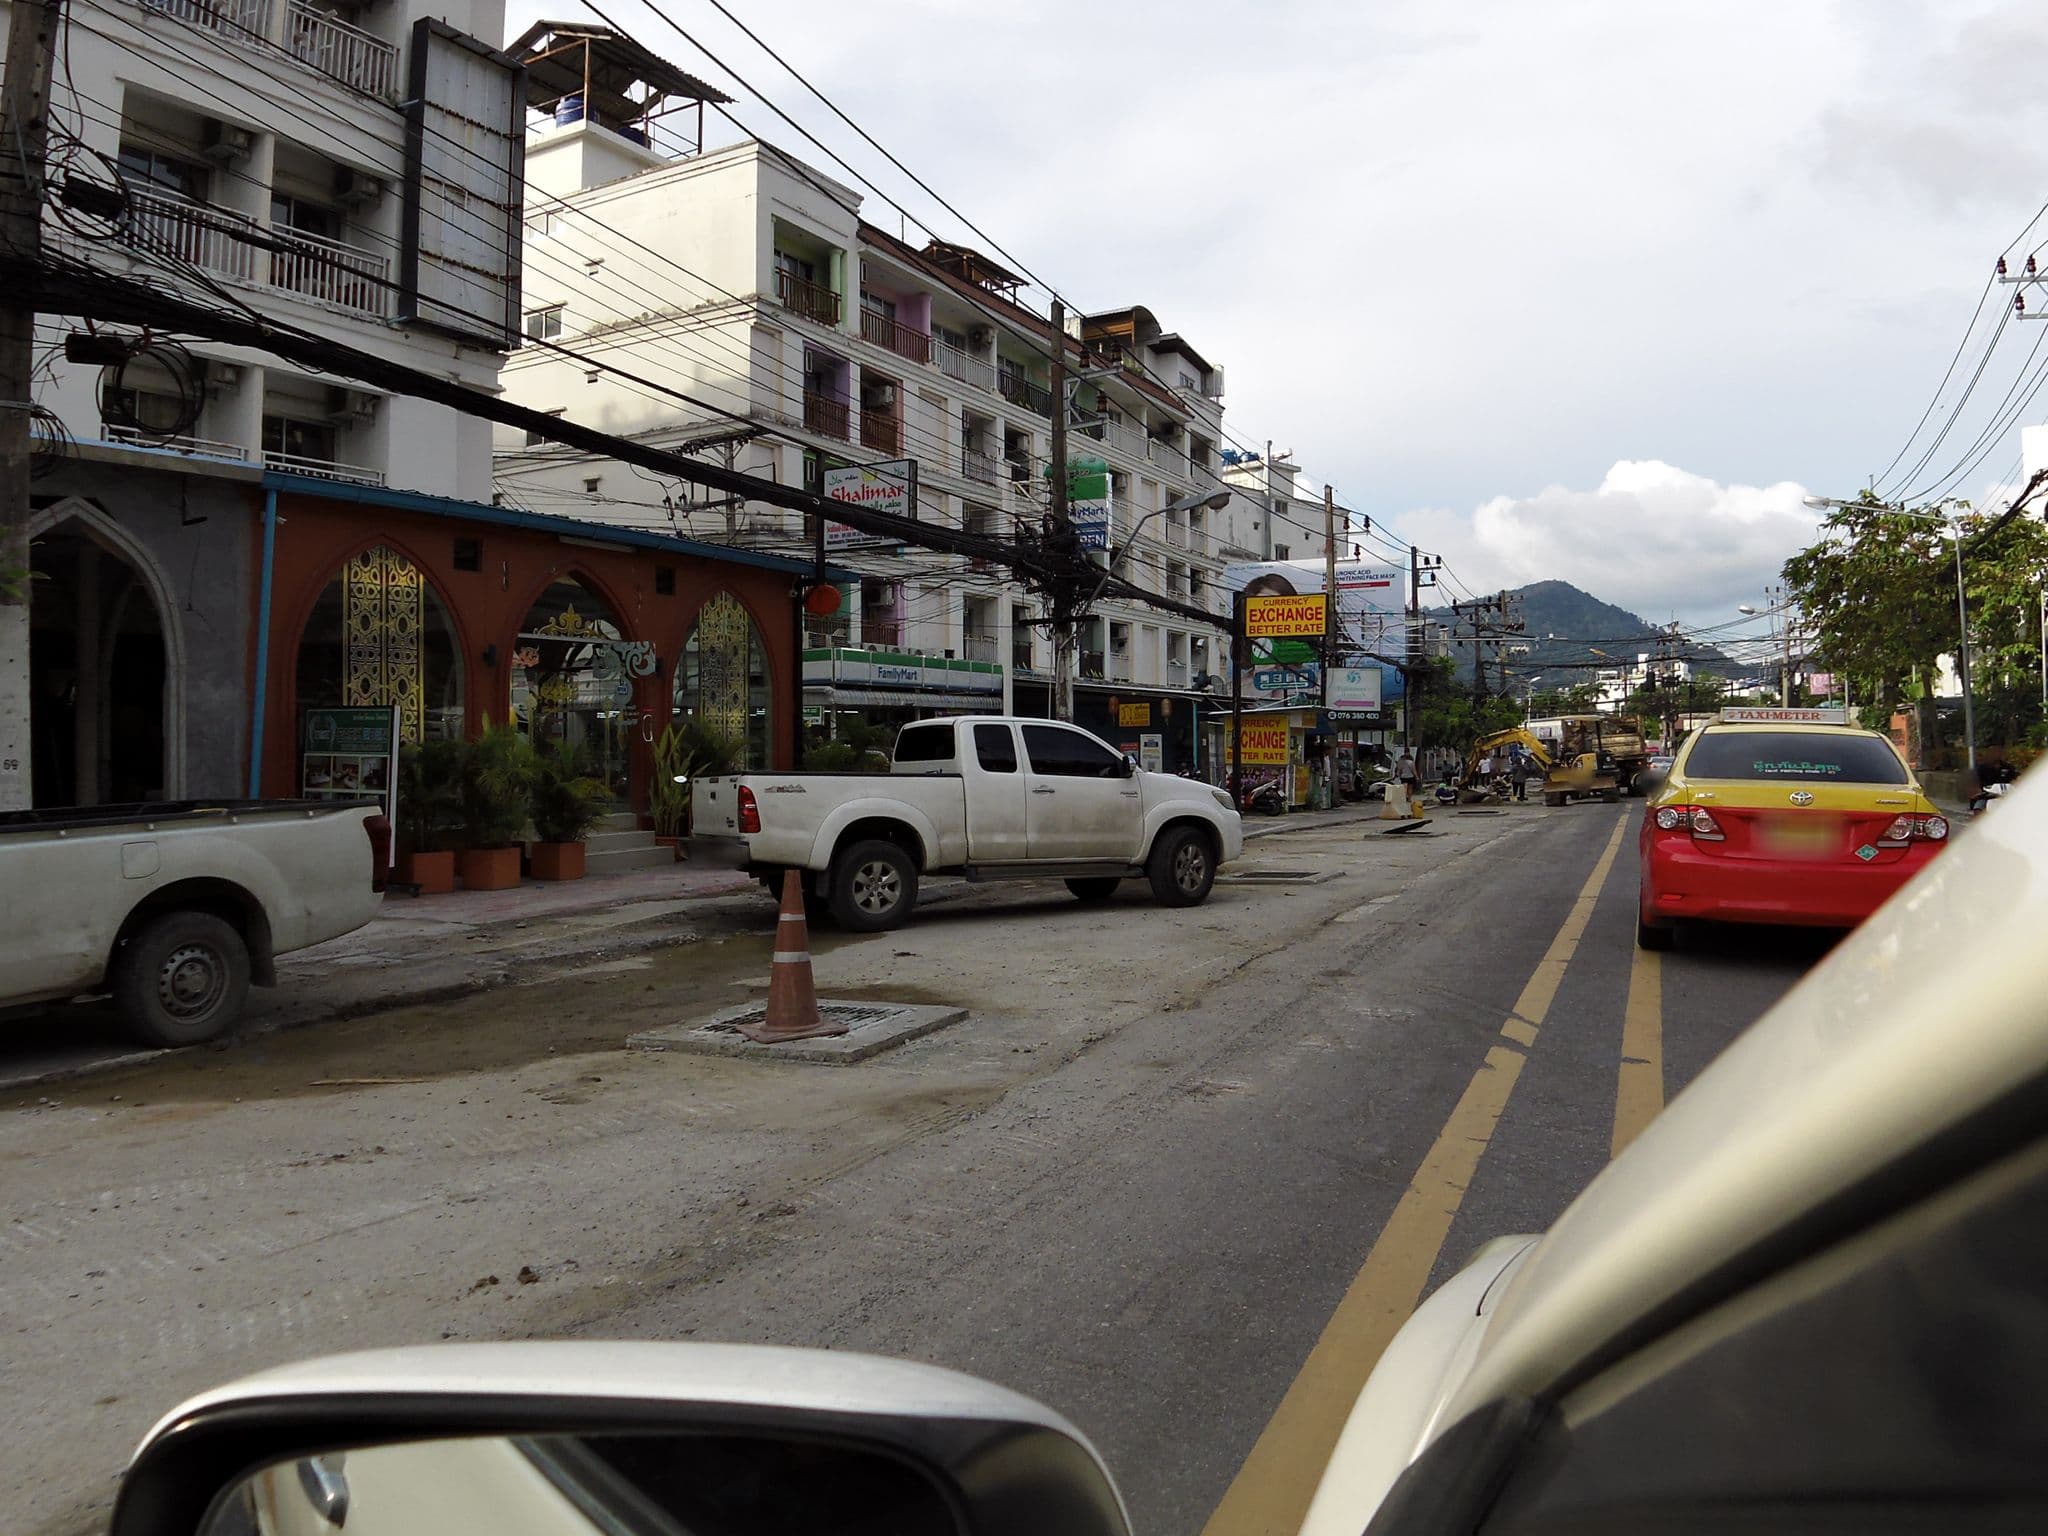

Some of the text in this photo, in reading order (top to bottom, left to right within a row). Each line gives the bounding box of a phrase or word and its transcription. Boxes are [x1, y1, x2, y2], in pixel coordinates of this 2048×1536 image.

[831, 484, 905, 502] Shalimar
[1263, 598, 1309, 606] CURRENCY
[1249, 607, 1323, 623] EXCHANGE
[1249, 623, 1324, 634] BETTER RATE
[878, 666, 917, 682] FamilyMart
[1263, 752, 1285, 760] RATE
